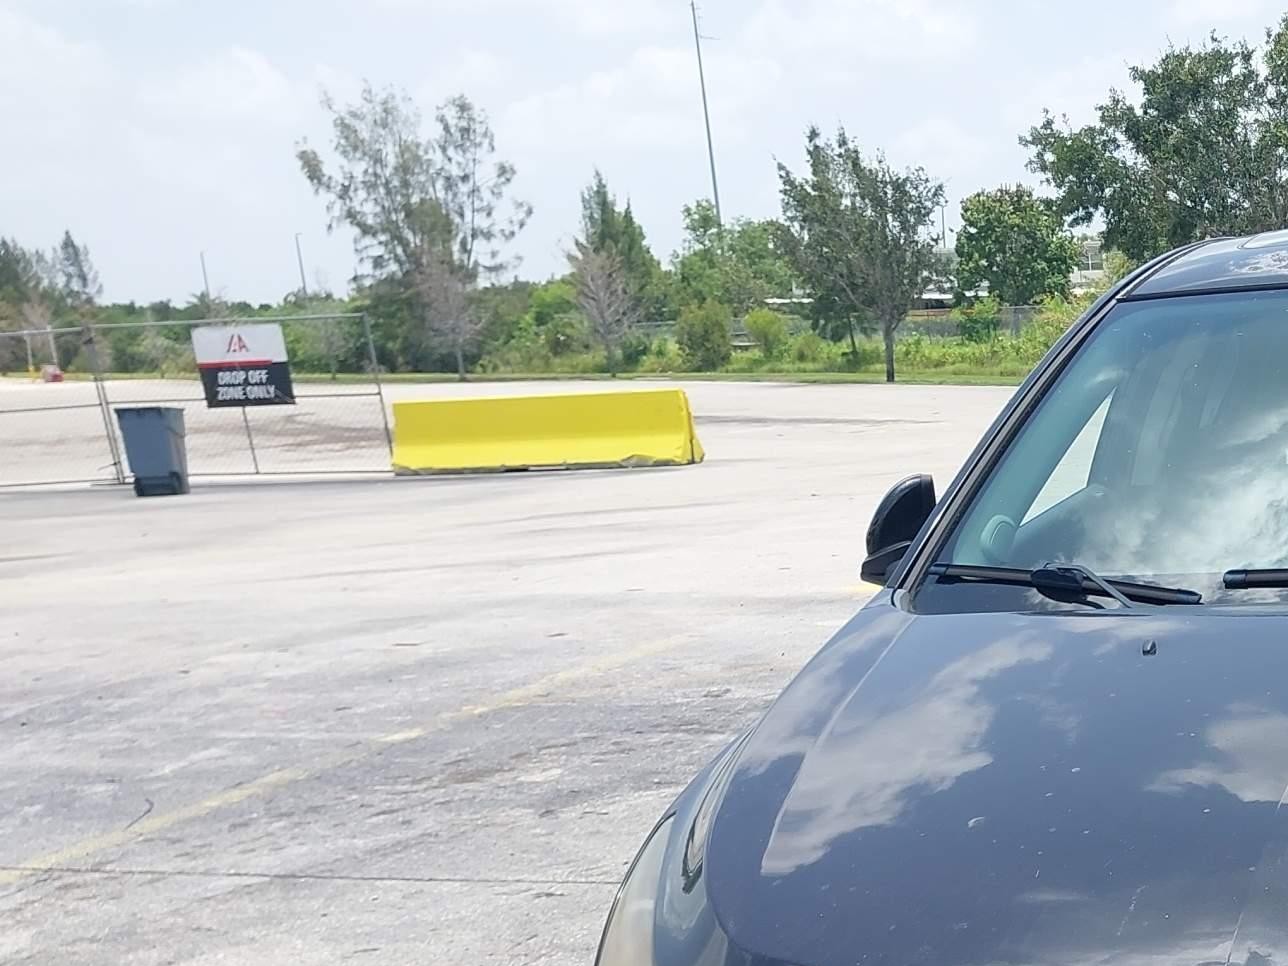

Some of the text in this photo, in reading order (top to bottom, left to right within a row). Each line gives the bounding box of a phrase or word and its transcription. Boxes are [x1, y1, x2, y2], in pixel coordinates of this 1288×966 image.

[217, 369, 269, 385] DROP OFF
[216, 384, 275, 400] ZONE ONLY
